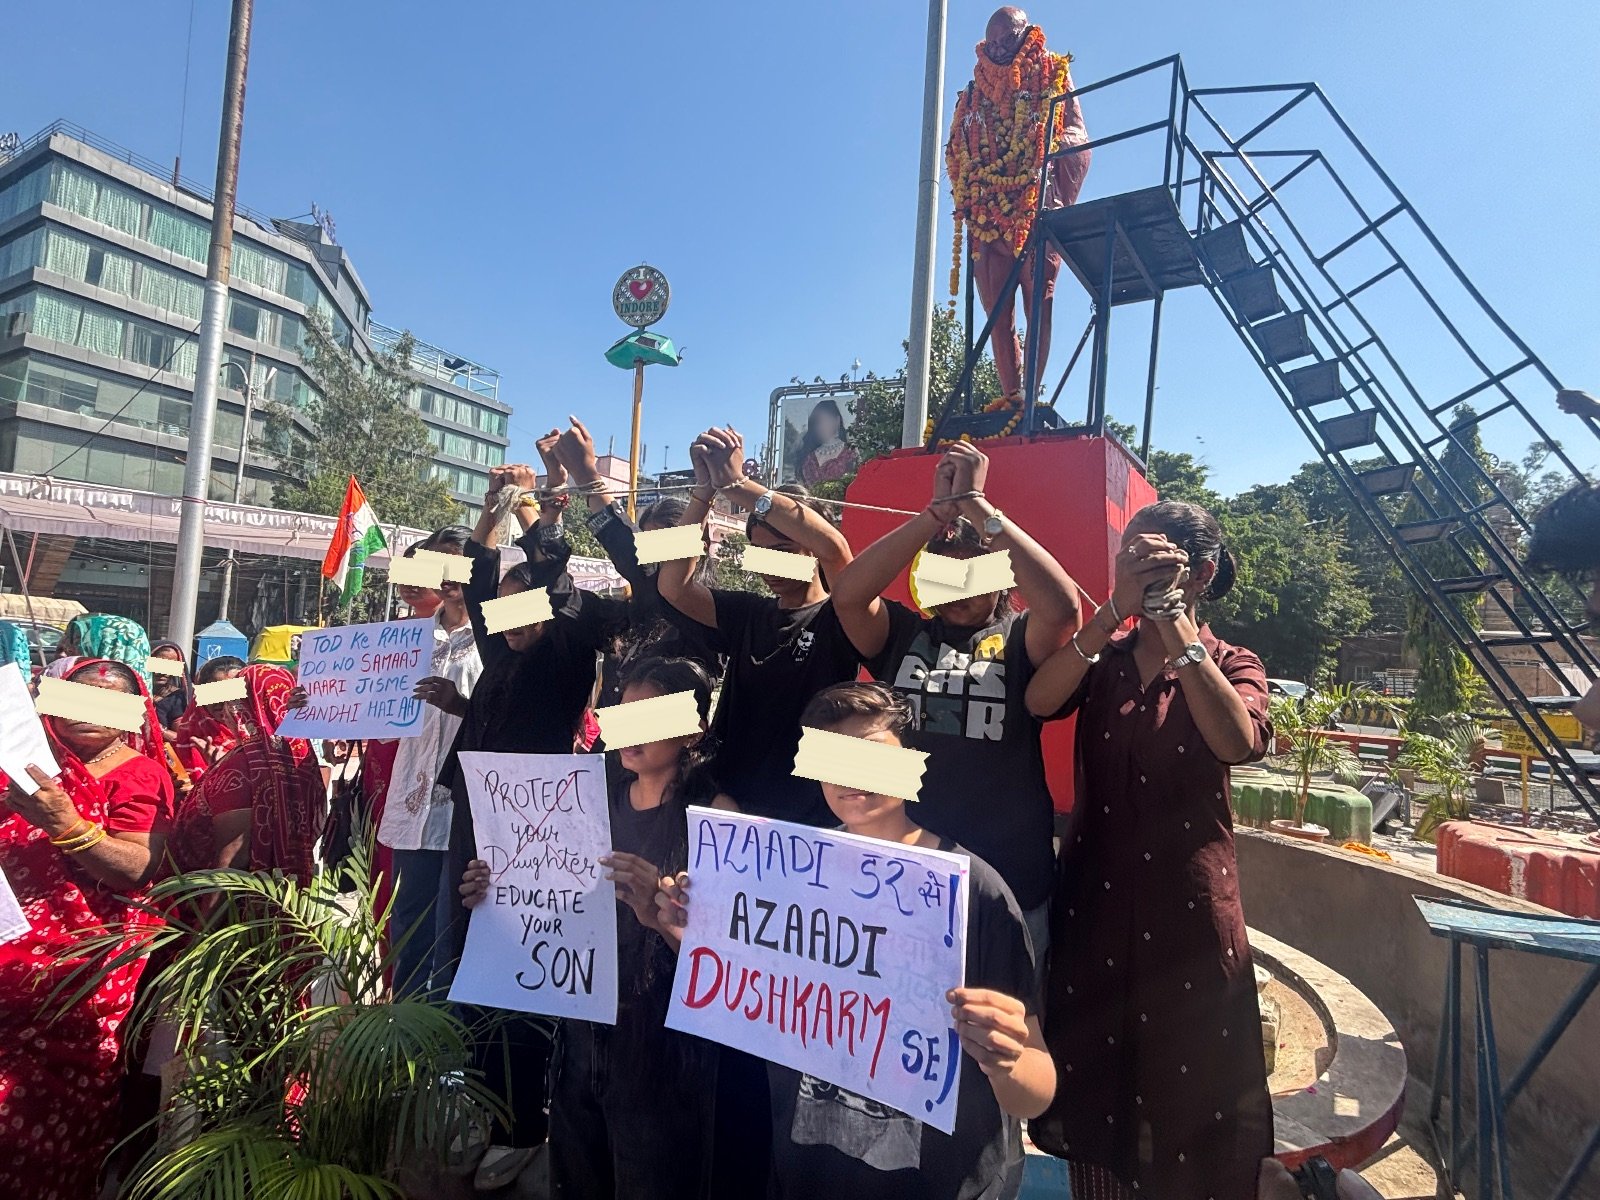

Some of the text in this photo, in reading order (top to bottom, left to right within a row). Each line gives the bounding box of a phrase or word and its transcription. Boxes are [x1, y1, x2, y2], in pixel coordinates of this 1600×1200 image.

[639, 268, 645, 279] I
[620, 301, 659, 313] INDORE
[313, 634, 343, 655] TOD
[377, 626, 423, 648] RAKH
[302, 649, 422, 677] DO WO SAMAAJ
[355, 675, 409, 694] JISME
[294, 702, 362, 723] BANDHI
[367, 699, 397, 719] HAI
[484, 769, 591, 814] PROTECT
[511, 822, 560, 853] your
[483, 844, 597, 881] Daughter
[695, 819, 834, 889] AZAADI
[495, 884, 585, 914] EDUCATE
[520, 914, 564, 946] YOUR
[729, 891, 888, 979] AZAADI
[515, 940, 596, 995] SON
[680, 946, 891, 1080] DUSHKARM
